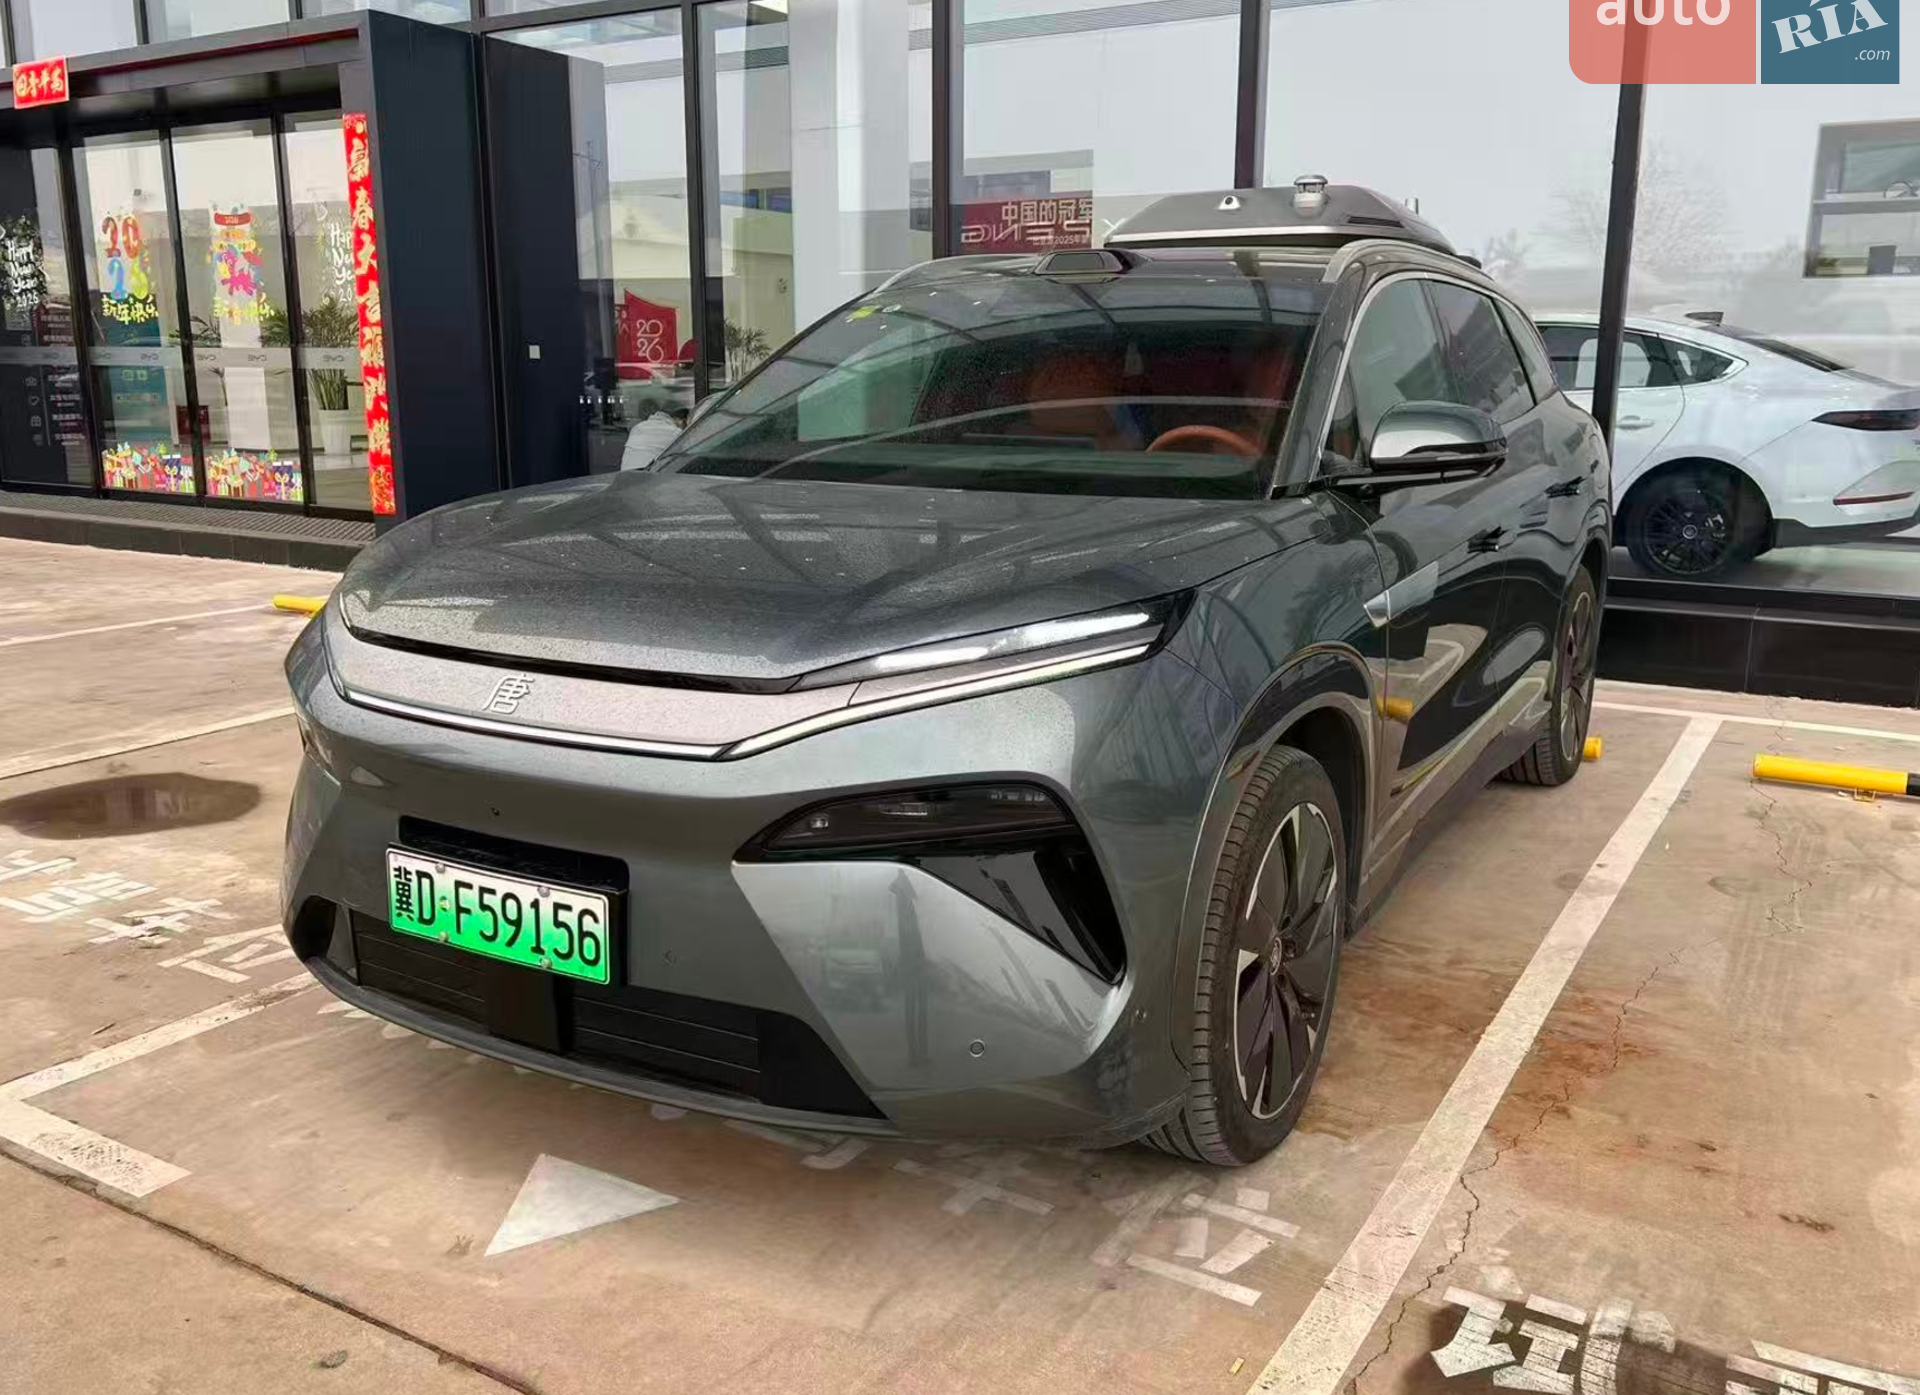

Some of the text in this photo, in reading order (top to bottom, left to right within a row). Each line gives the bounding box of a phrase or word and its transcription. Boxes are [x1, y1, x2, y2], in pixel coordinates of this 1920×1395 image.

[1001, 198, 1093, 227] 中国的冠军
[330, 222, 353, 248] Hap
[334, 266, 354, 285] Ye
[16, 292, 40, 308] 2026
[338, 287, 353, 303] 20
[637, 338, 664, 363] 26
[483, 674, 535, 714] 唐
